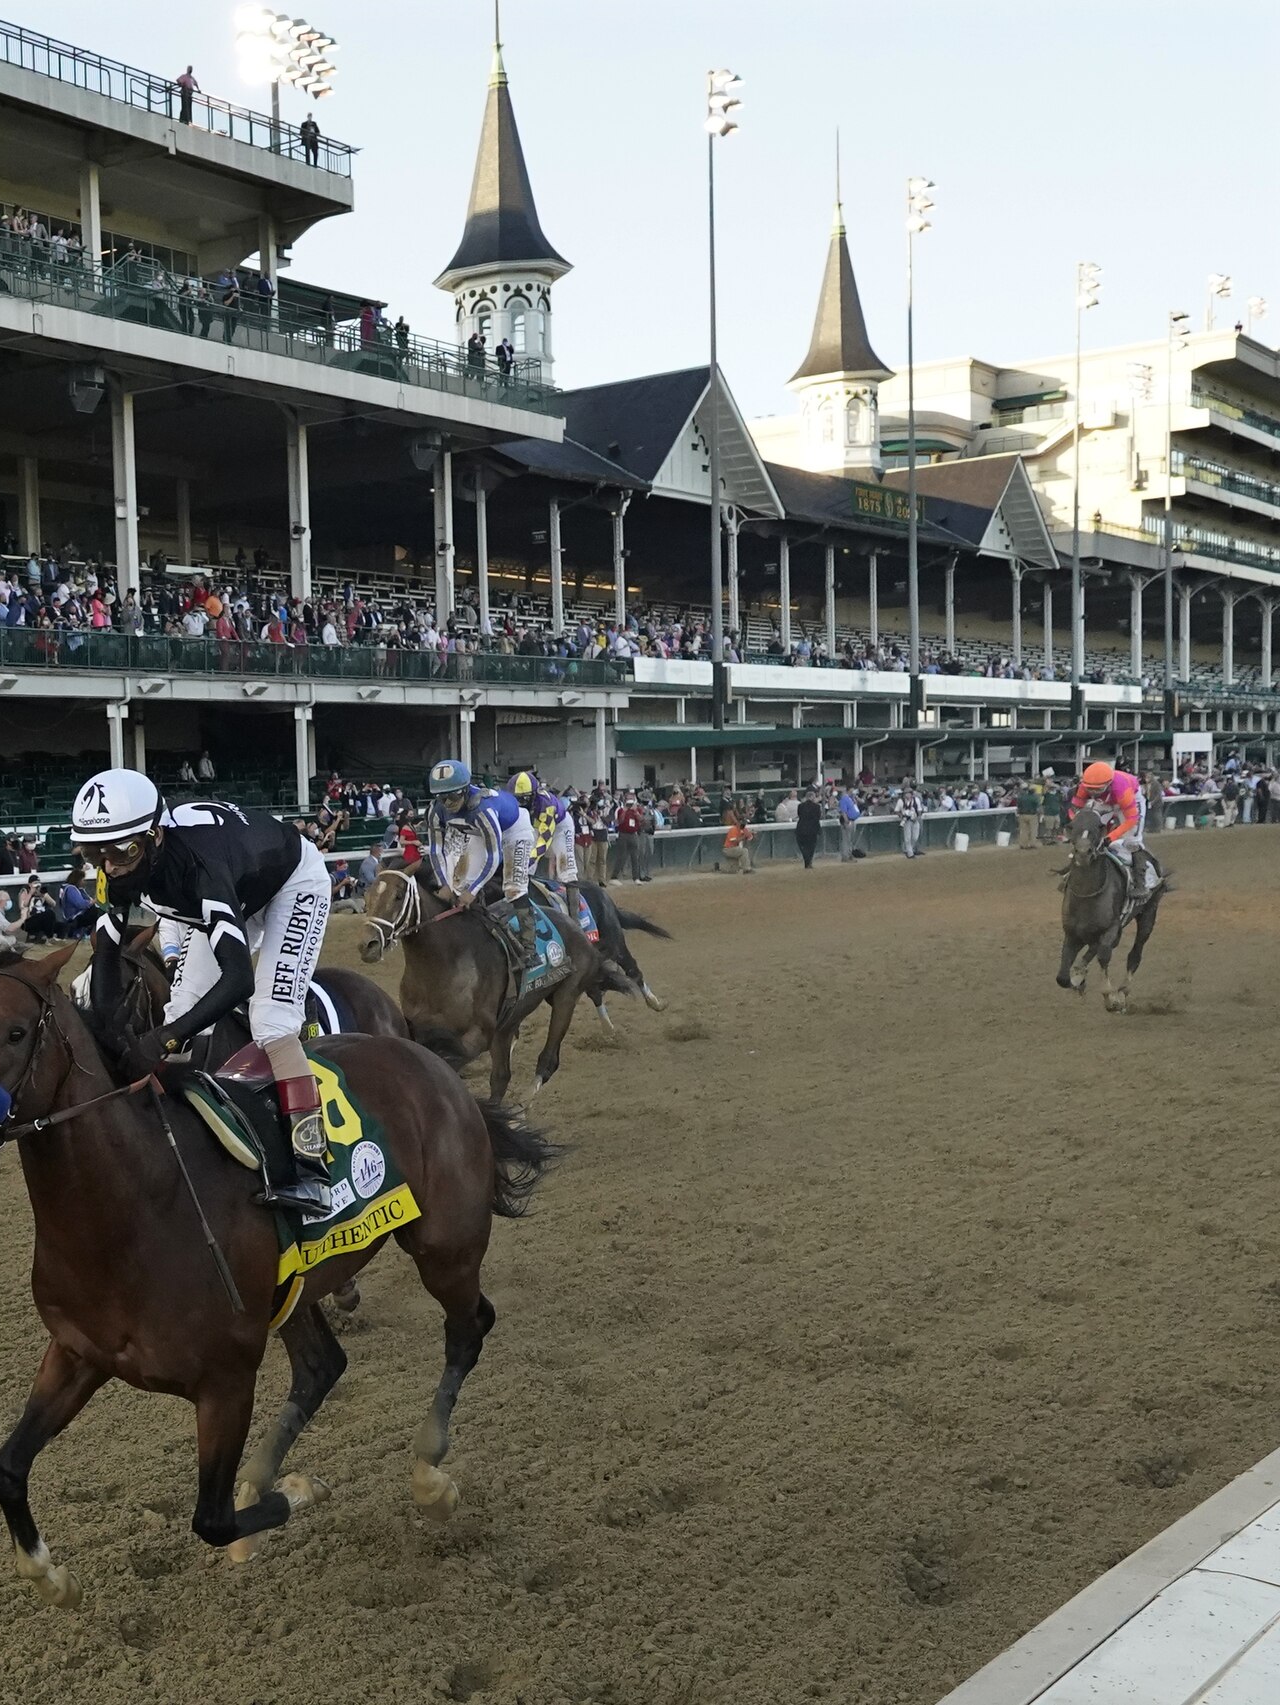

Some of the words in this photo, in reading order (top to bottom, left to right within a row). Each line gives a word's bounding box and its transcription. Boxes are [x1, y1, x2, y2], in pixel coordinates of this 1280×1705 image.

[858, 497, 881, 512] 1875
[436, 765, 450, 779] T
[96, 869, 107, 904] 8
[280, 893, 315, 957] RUBY'S
[271, 961, 295, 1005] JEFF
[303, 1200, 404, 1265] UTHENTIC
